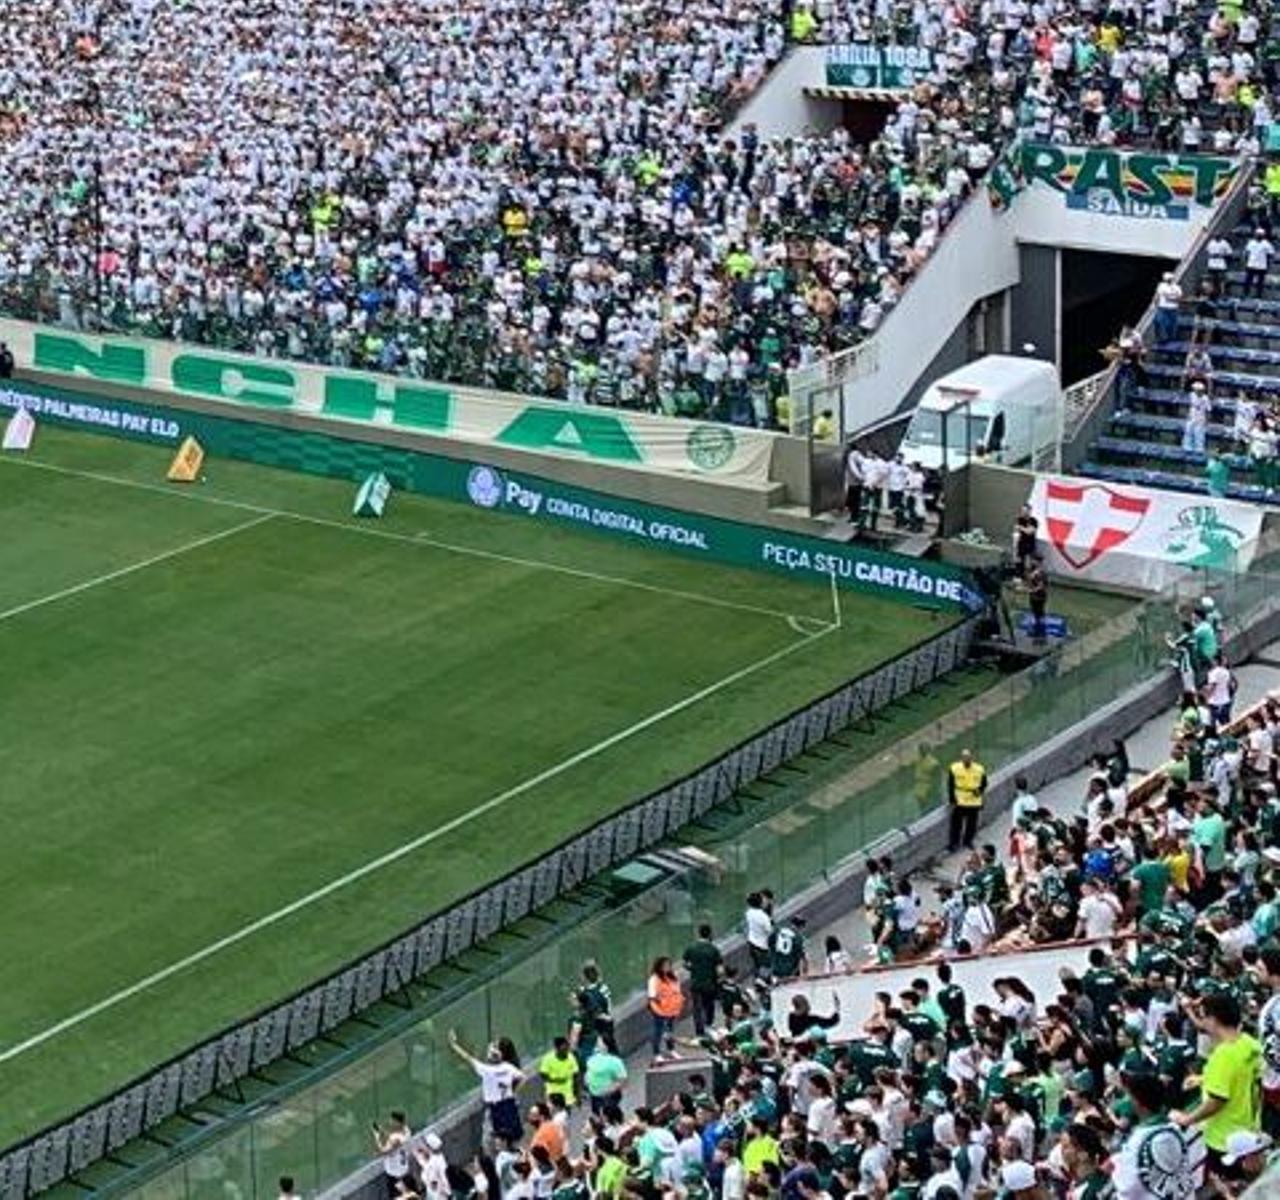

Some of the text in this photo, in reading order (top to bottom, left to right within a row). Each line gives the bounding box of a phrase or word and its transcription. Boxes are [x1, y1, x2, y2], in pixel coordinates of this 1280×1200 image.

[43, 399, 120, 427] PALMEIRAS
[122, 411, 151, 433] PAY
[151, 417, 180, 438] ELO
[506, 481, 709, 549] Pay CONTA DIGITAL OFICIAL
[762, 542, 811, 569] PEÇA
[855, 561, 932, 594] CARTÃO
[935, 578, 961, 601] DE
